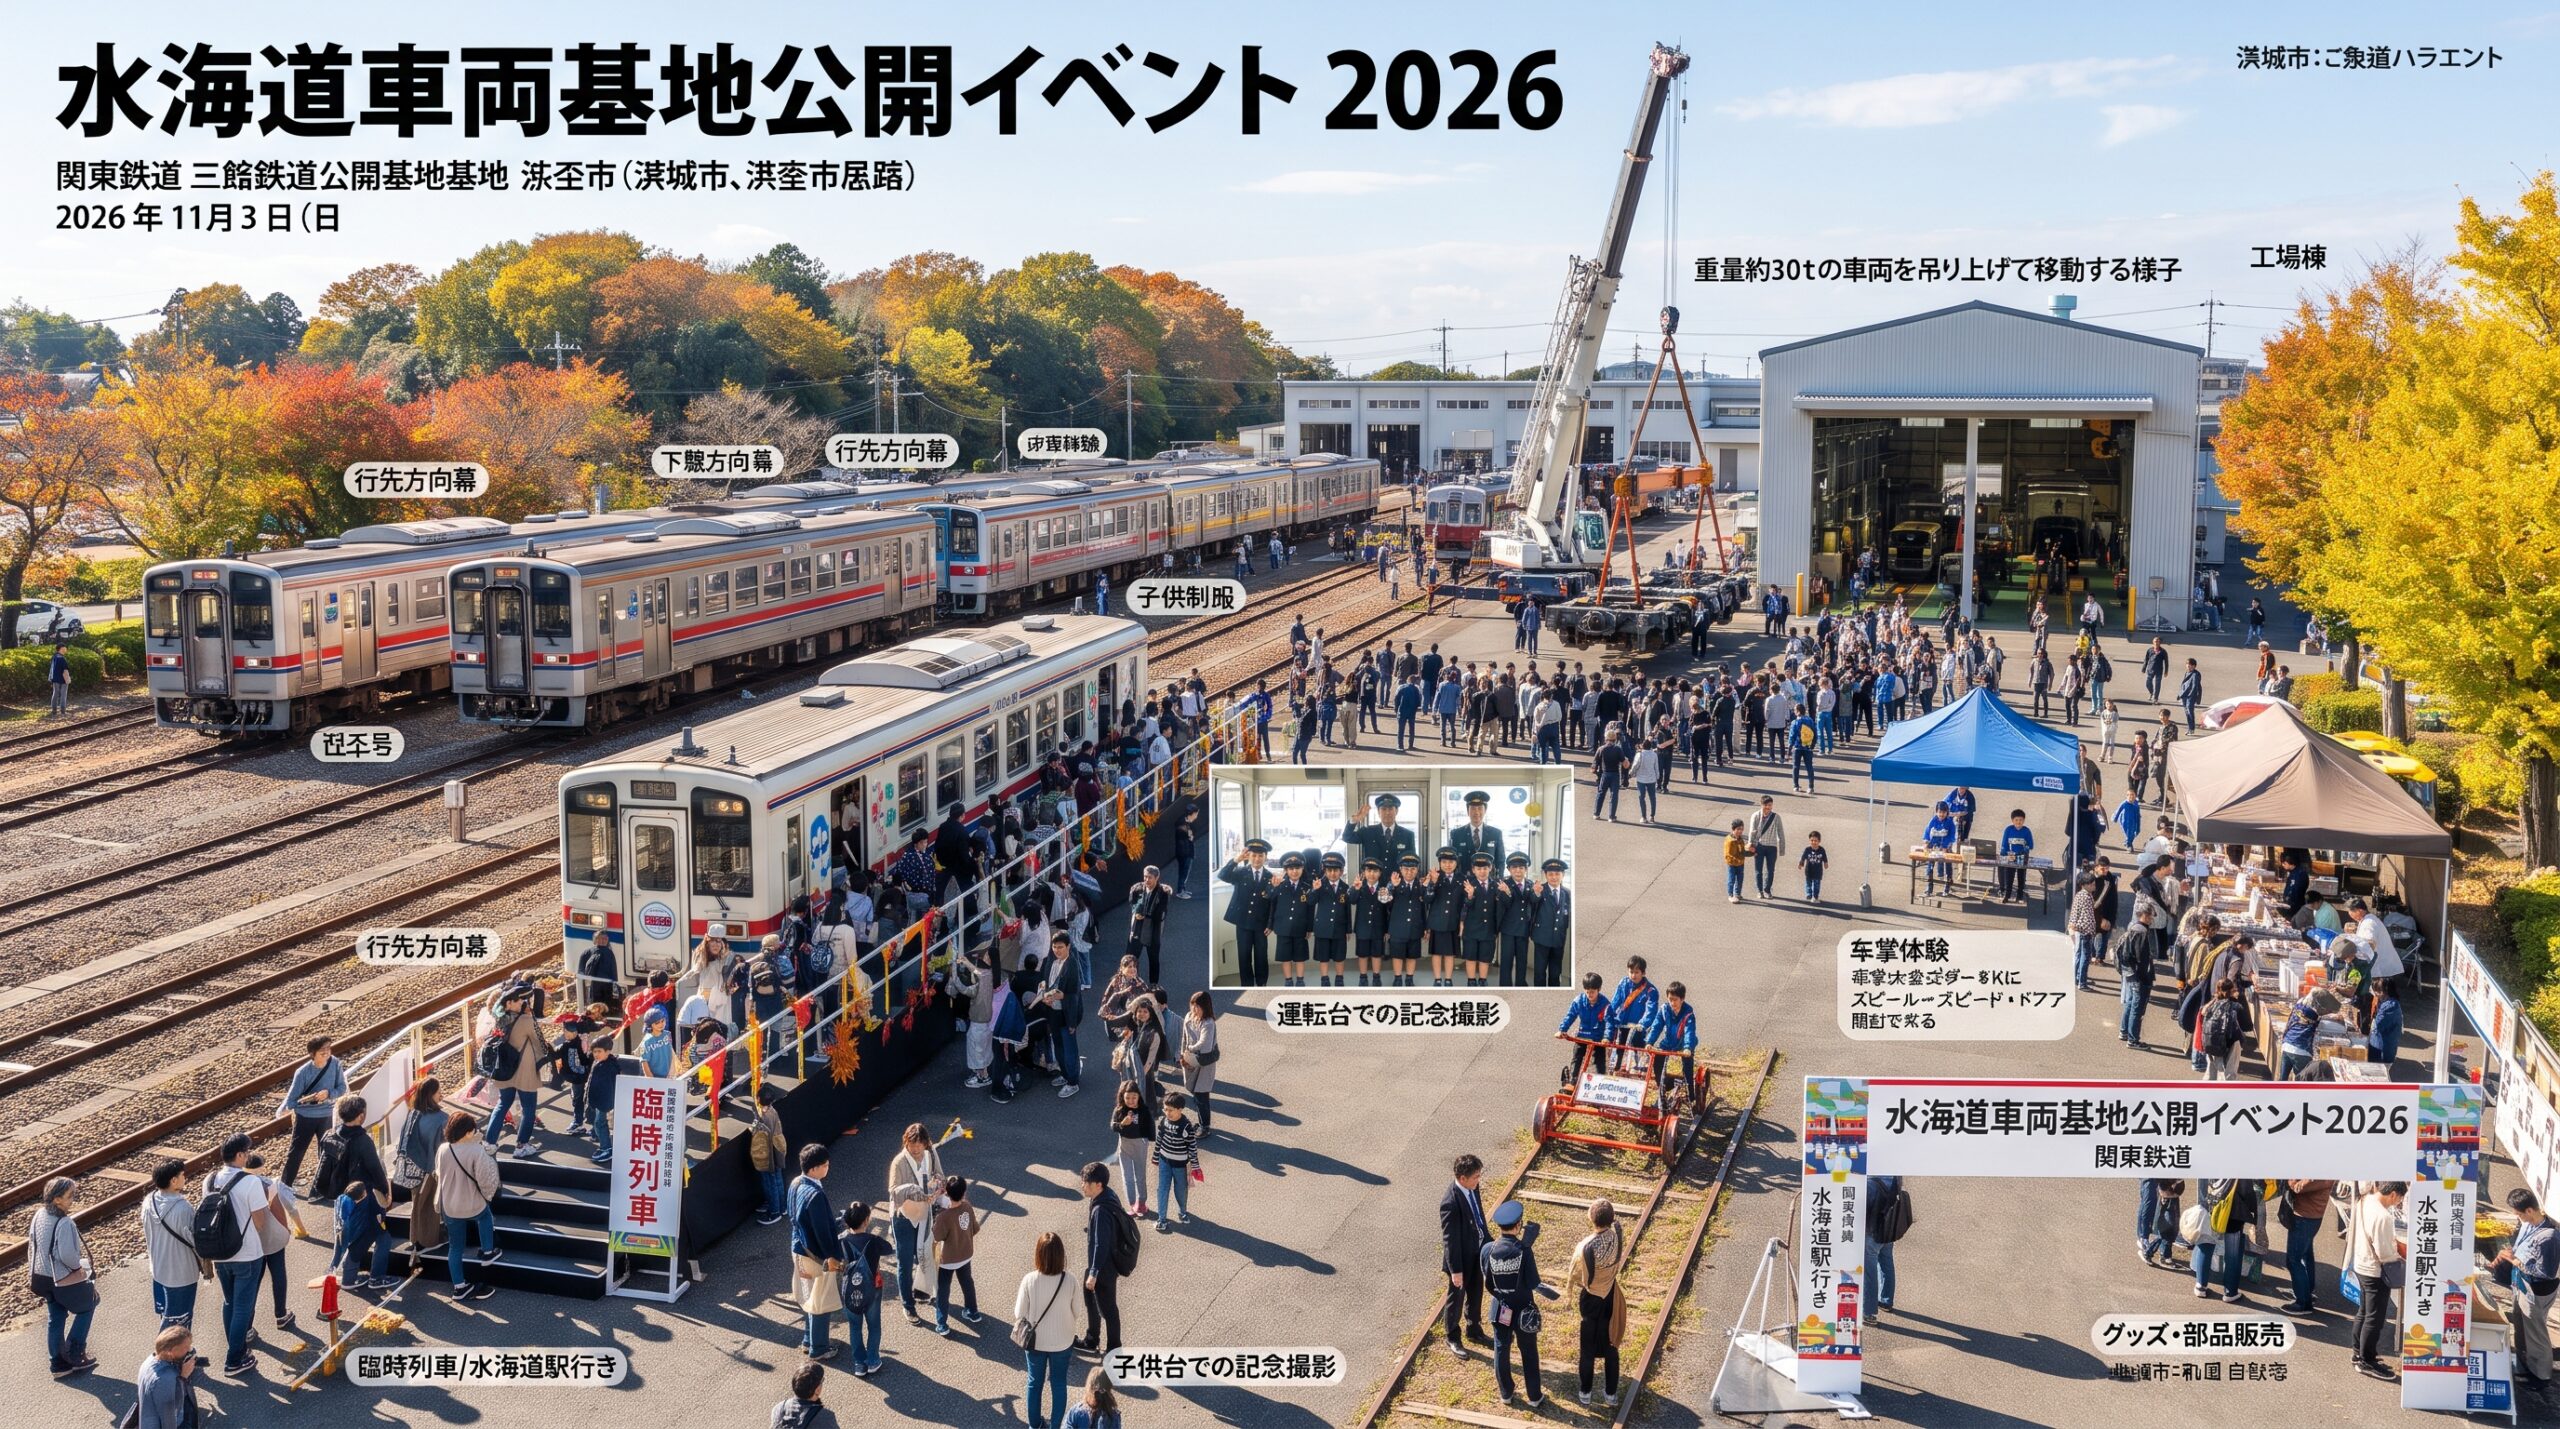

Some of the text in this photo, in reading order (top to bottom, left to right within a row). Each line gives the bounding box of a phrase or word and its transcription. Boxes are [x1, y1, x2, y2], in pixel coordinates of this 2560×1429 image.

[626, 1088, 665, 1226] 臨時列車
[1886, 1099, 2408, 1136] 水海道車両基地公開イベント2026
[2096, 1145, 2191, 1168] 関東鉄道
[1811, 1187, 1831, 1308] 水海道駅行き
[2415, 1196, 2438, 1316] 水海道駅行き
